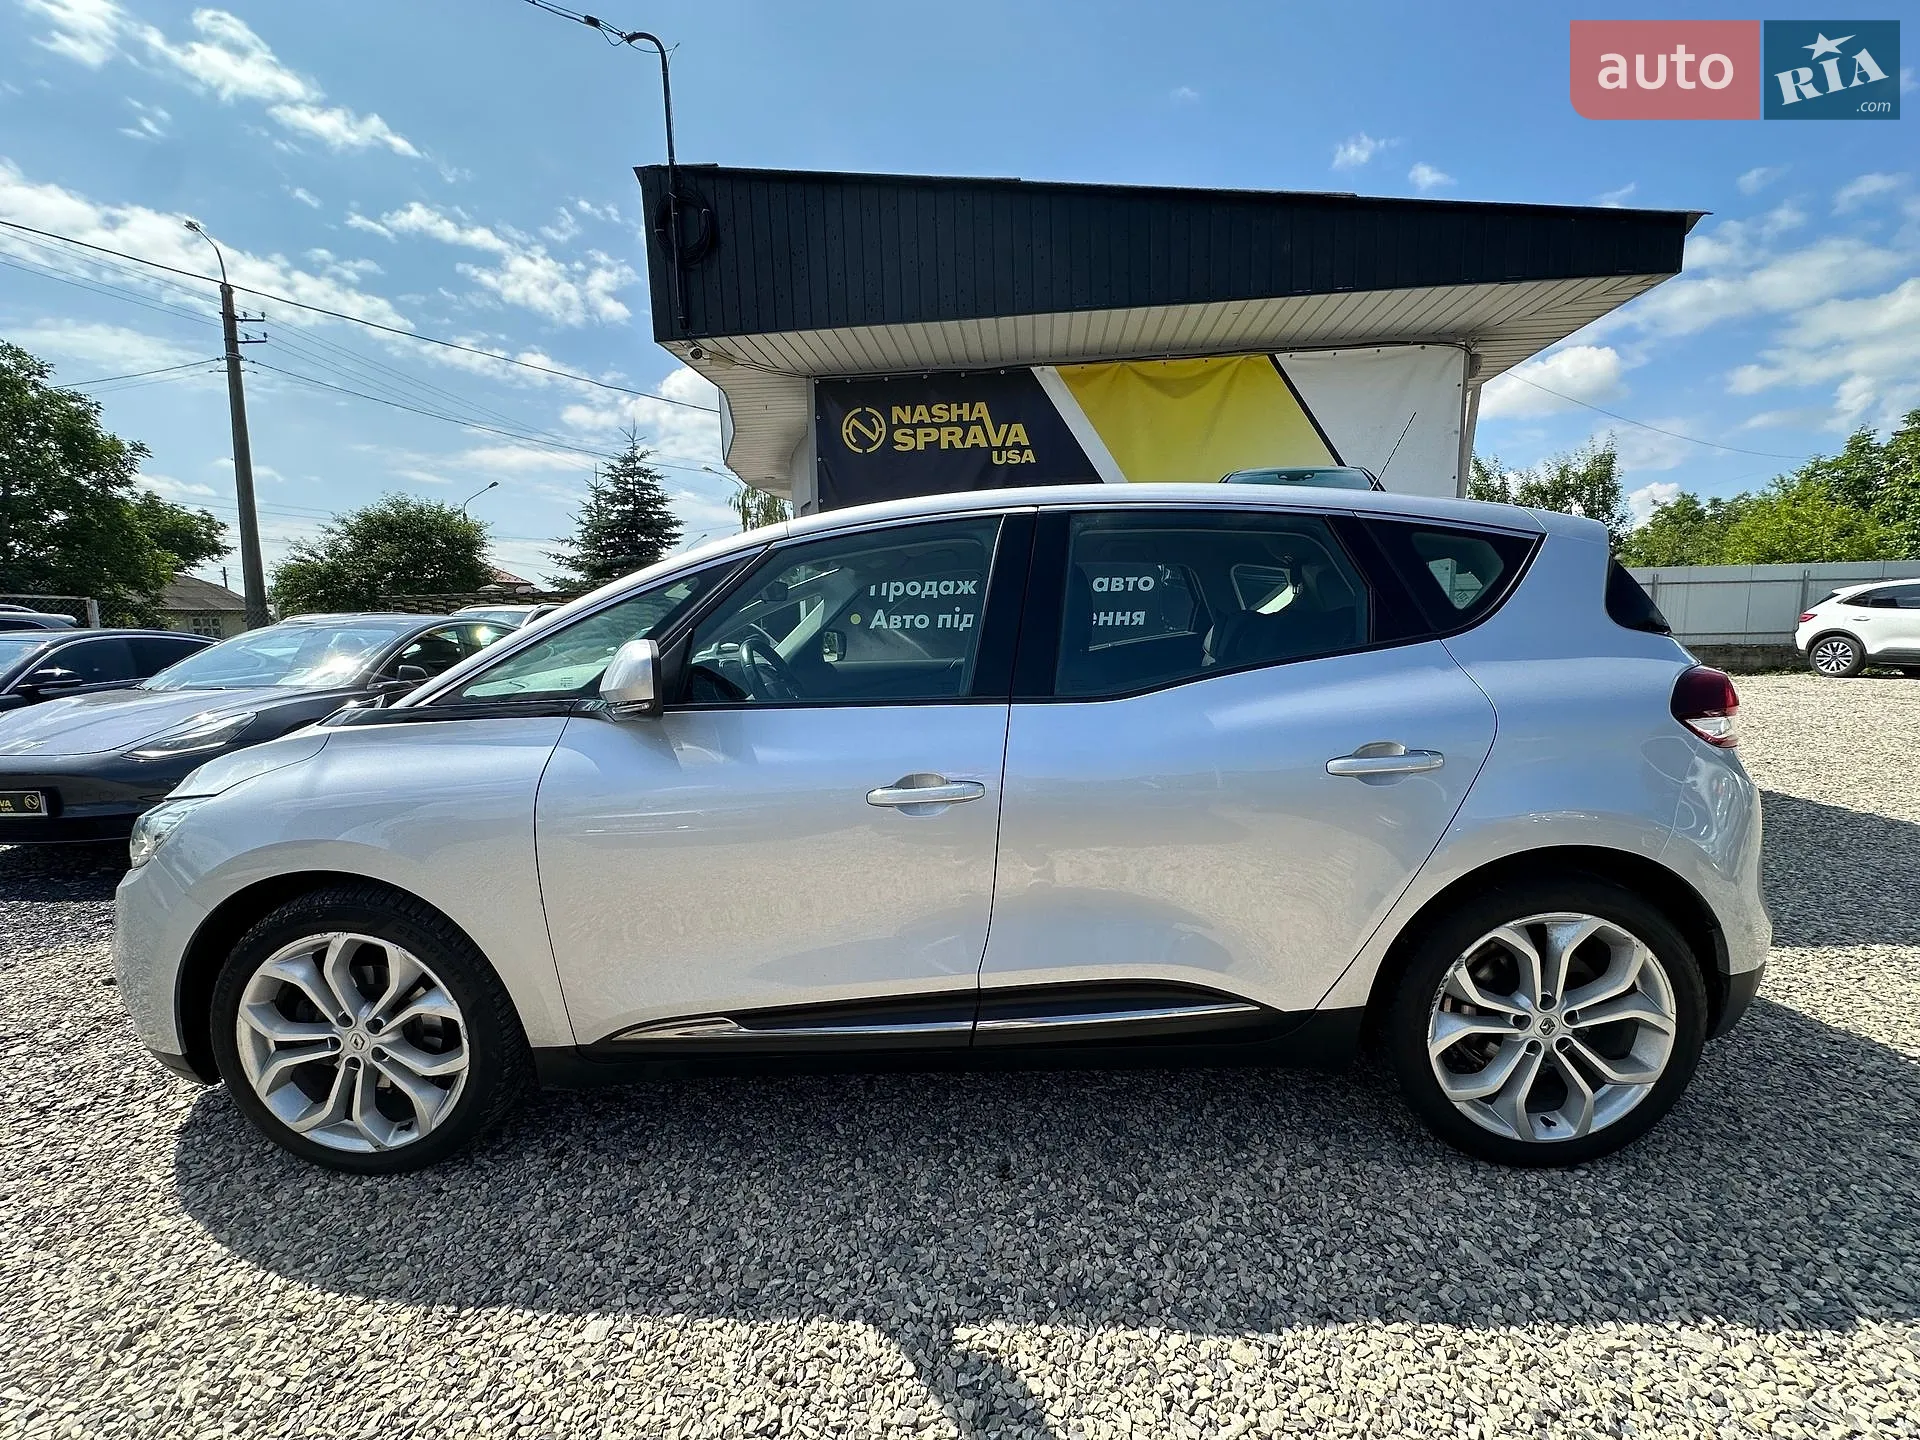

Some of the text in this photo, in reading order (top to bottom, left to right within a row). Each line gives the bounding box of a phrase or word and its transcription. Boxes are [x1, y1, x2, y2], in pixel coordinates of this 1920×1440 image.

[891, 401, 988, 425] NASHA
[893, 423, 1030, 452] SPRAVA
[992, 450, 1036, 465] USA
[1092, 576, 1155, 593] авто
[869, 608, 930, 629] Авто
